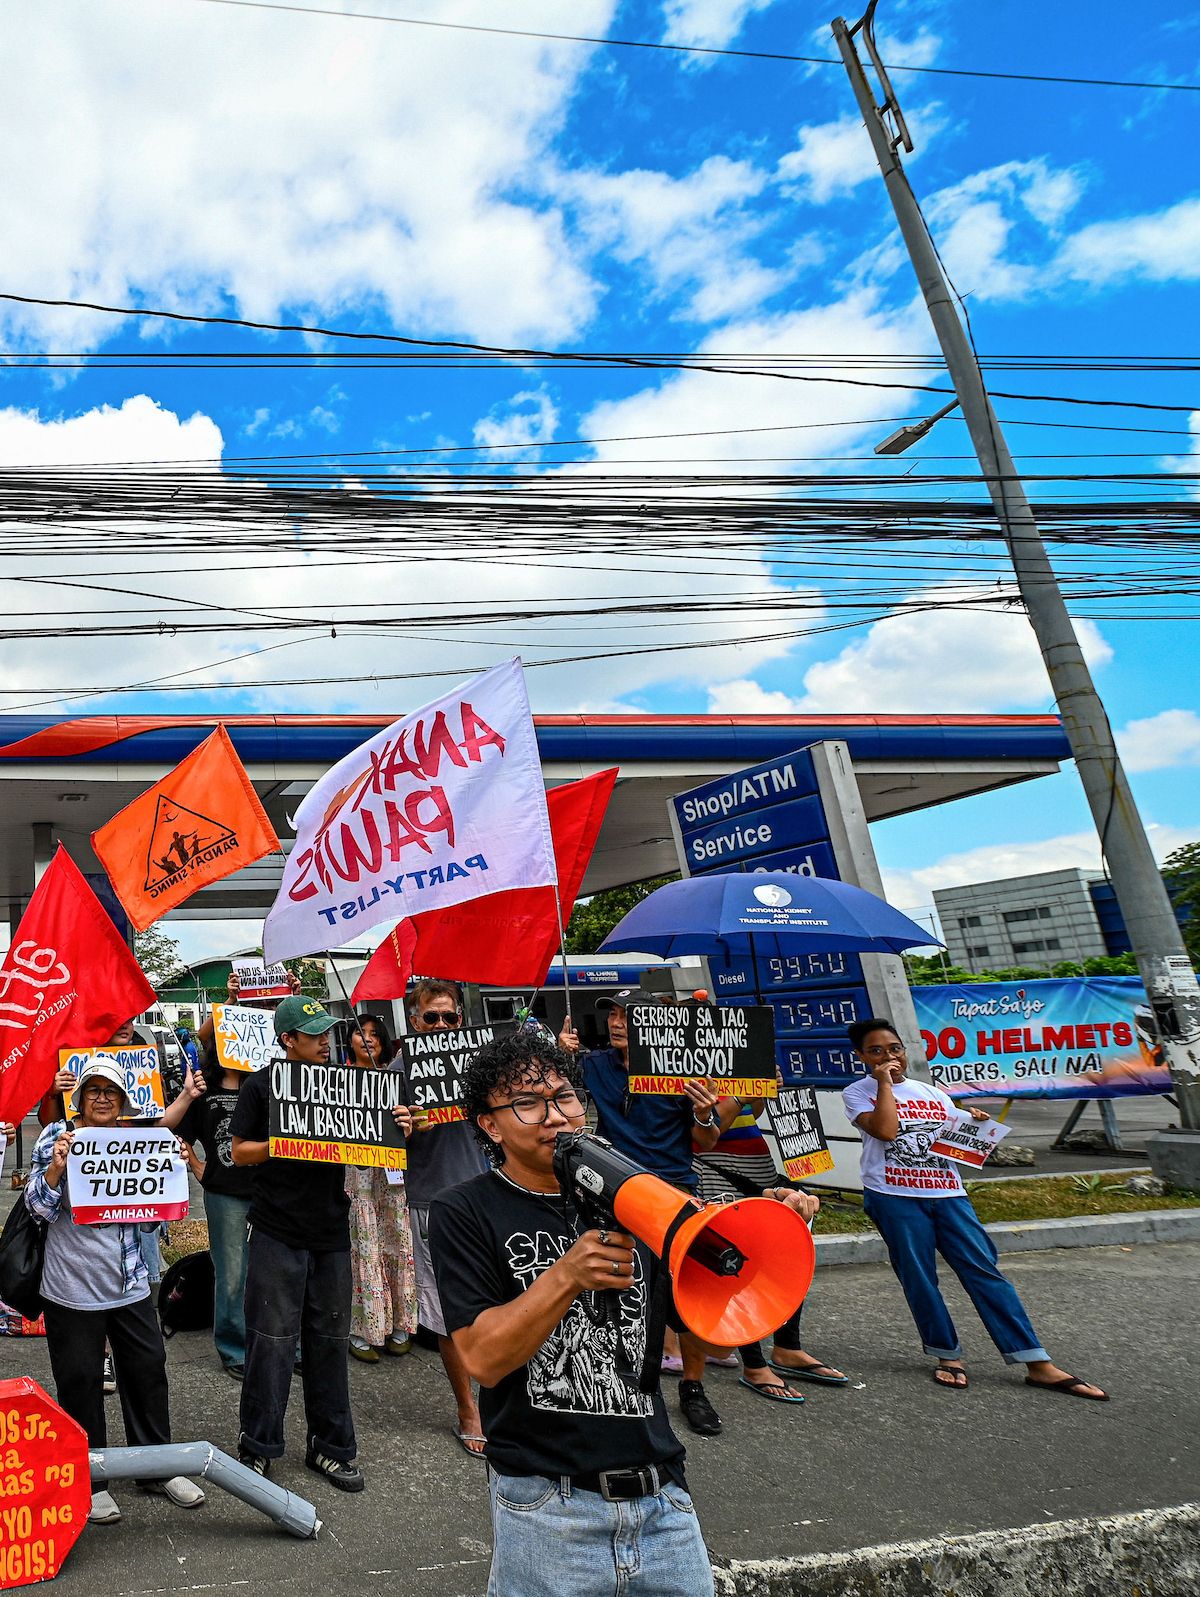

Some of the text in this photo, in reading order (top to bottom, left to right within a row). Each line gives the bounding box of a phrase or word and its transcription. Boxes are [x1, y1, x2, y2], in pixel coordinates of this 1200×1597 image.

[683, 764, 797, 822] Shop/ATM
[693, 823, 772, 862] Service
[237, 968, 251, 977] END
[240, 977, 257, 987] WAR
[259, 976, 268, 985] ON
[718, 971, 746, 985] Diesel
[256, 988, 272, 996] LFS
[224, 1008, 267, 1026] Excise
[632, 1006, 748, 1029] SERBISYO SA TAO,
[781, 1000, 856, 1026] 75.40
[950, 998, 1000, 1021] Tapat
[232, 1023, 267, 1046] VAT
[405, 1028, 494, 1056] TANGGALIN
[638, 1027, 748, 1048] HUWAG GAWING
[977, 1021, 1133, 1055] HELMETS
[410, 1057, 446, 1080] ANG
[650, 1047, 734, 1076] NEGOSYO!
[1014, 1056, 1056, 1077] SALI
[271, 1061, 399, 1110] OIL DEREGULATION
[414, 1085, 439, 1106] SA
[280, 1102, 311, 1138] LAW,
[314, 1106, 383, 1142] IBASURA!
[899, 1110, 947, 1121] LINGKOD
[71, 1140, 180, 1156] OIL CARTEL
[949, 1147, 965, 1159] LFS
[81, 1158, 173, 1175] GANID SA
[89, 1177, 165, 1197] TUBO!
[885, 1175, 960, 1190] MAKIBAKA!
[44, 1463, 75, 1487] ng
[41, 1504, 73, 1527] NG
